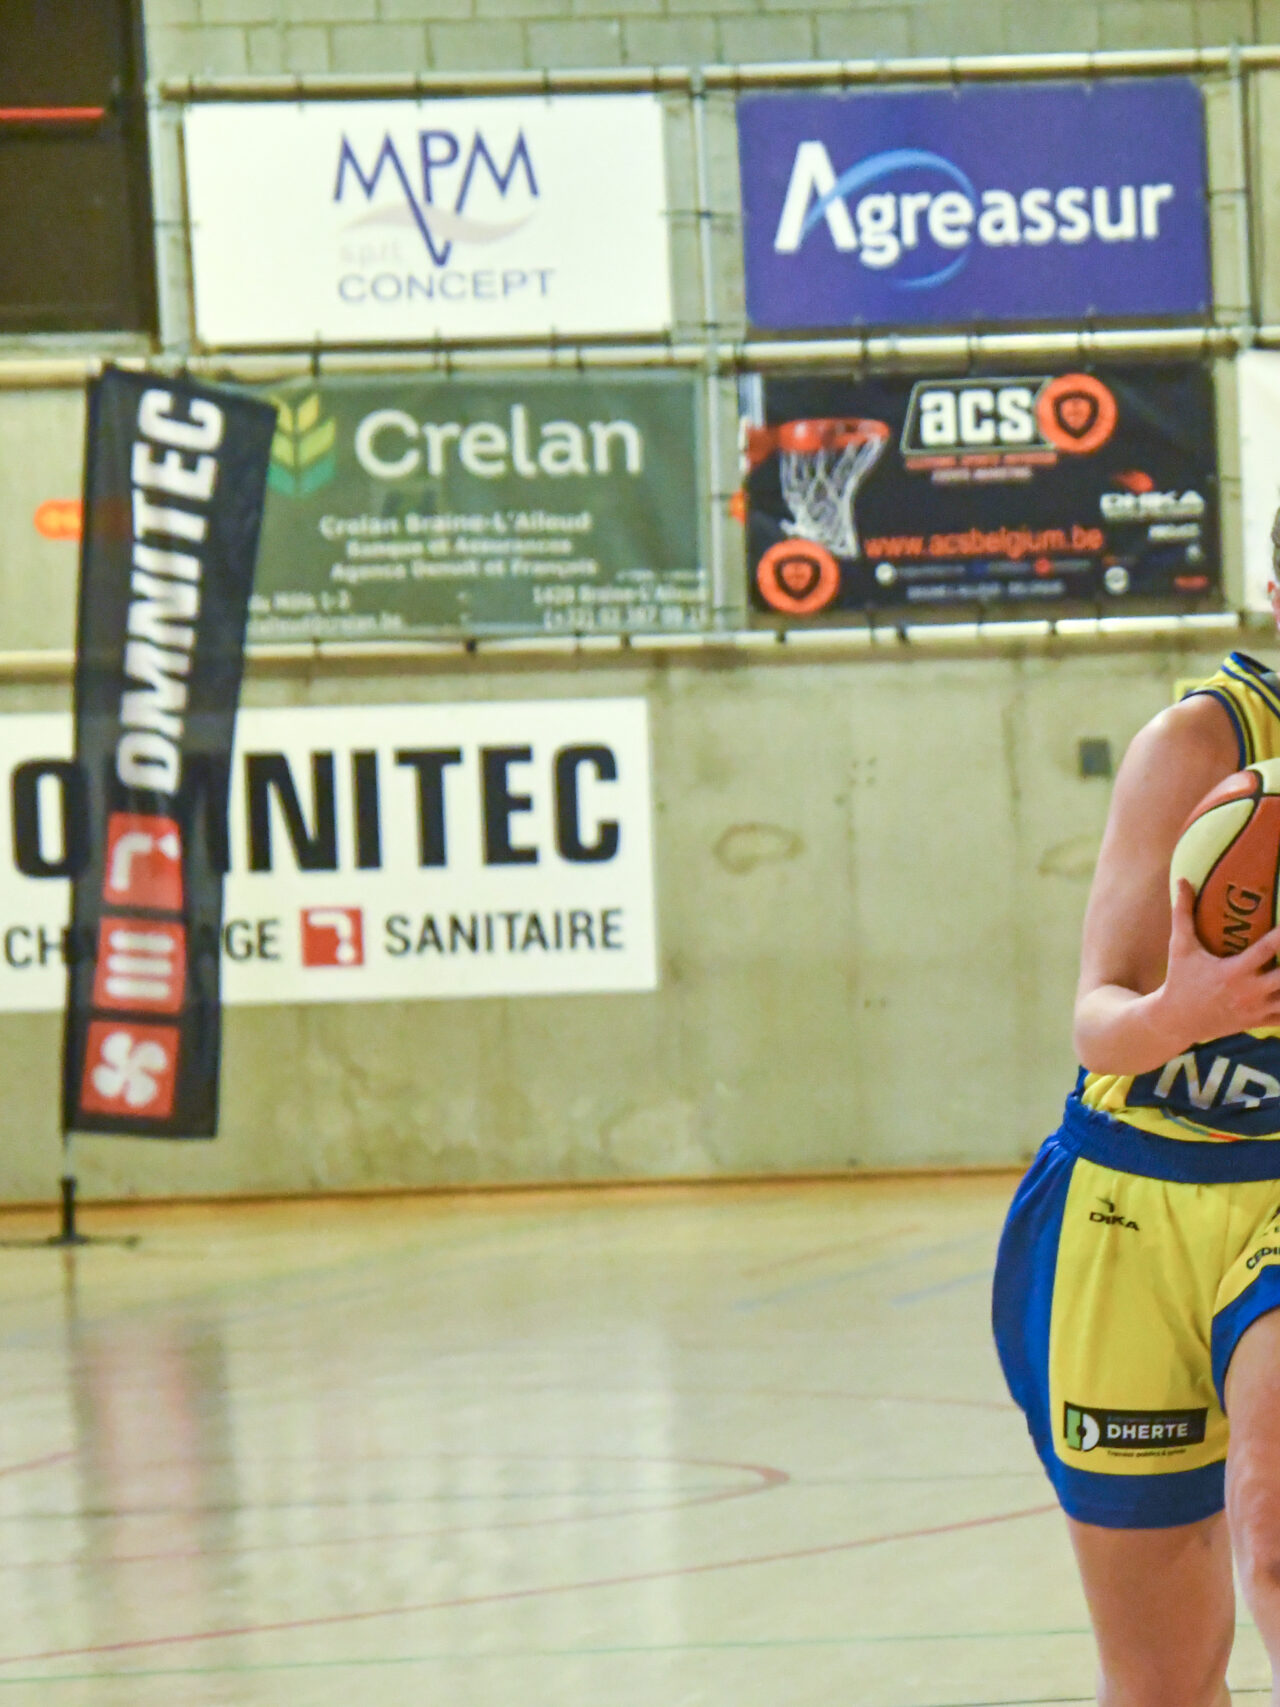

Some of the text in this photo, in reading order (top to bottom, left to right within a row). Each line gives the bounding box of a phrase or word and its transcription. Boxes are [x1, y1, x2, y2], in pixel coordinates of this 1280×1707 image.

[333, 125, 541, 267] MPM
[774, 139, 1175, 270] Agreassur
[337, 268, 558, 304] CONCEPT
[354, 403, 643, 478] Crelan
[919, 388, 1037, 447] acs
[115, 388, 226, 795] OMNITEC
[10, 743, 620, 879] ONITEC
[384, 908, 625, 956] SANITAIRE
[1089, 1211, 1140, 1231] DIKA
[1106, 1423, 1188, 1440] DHERTE
